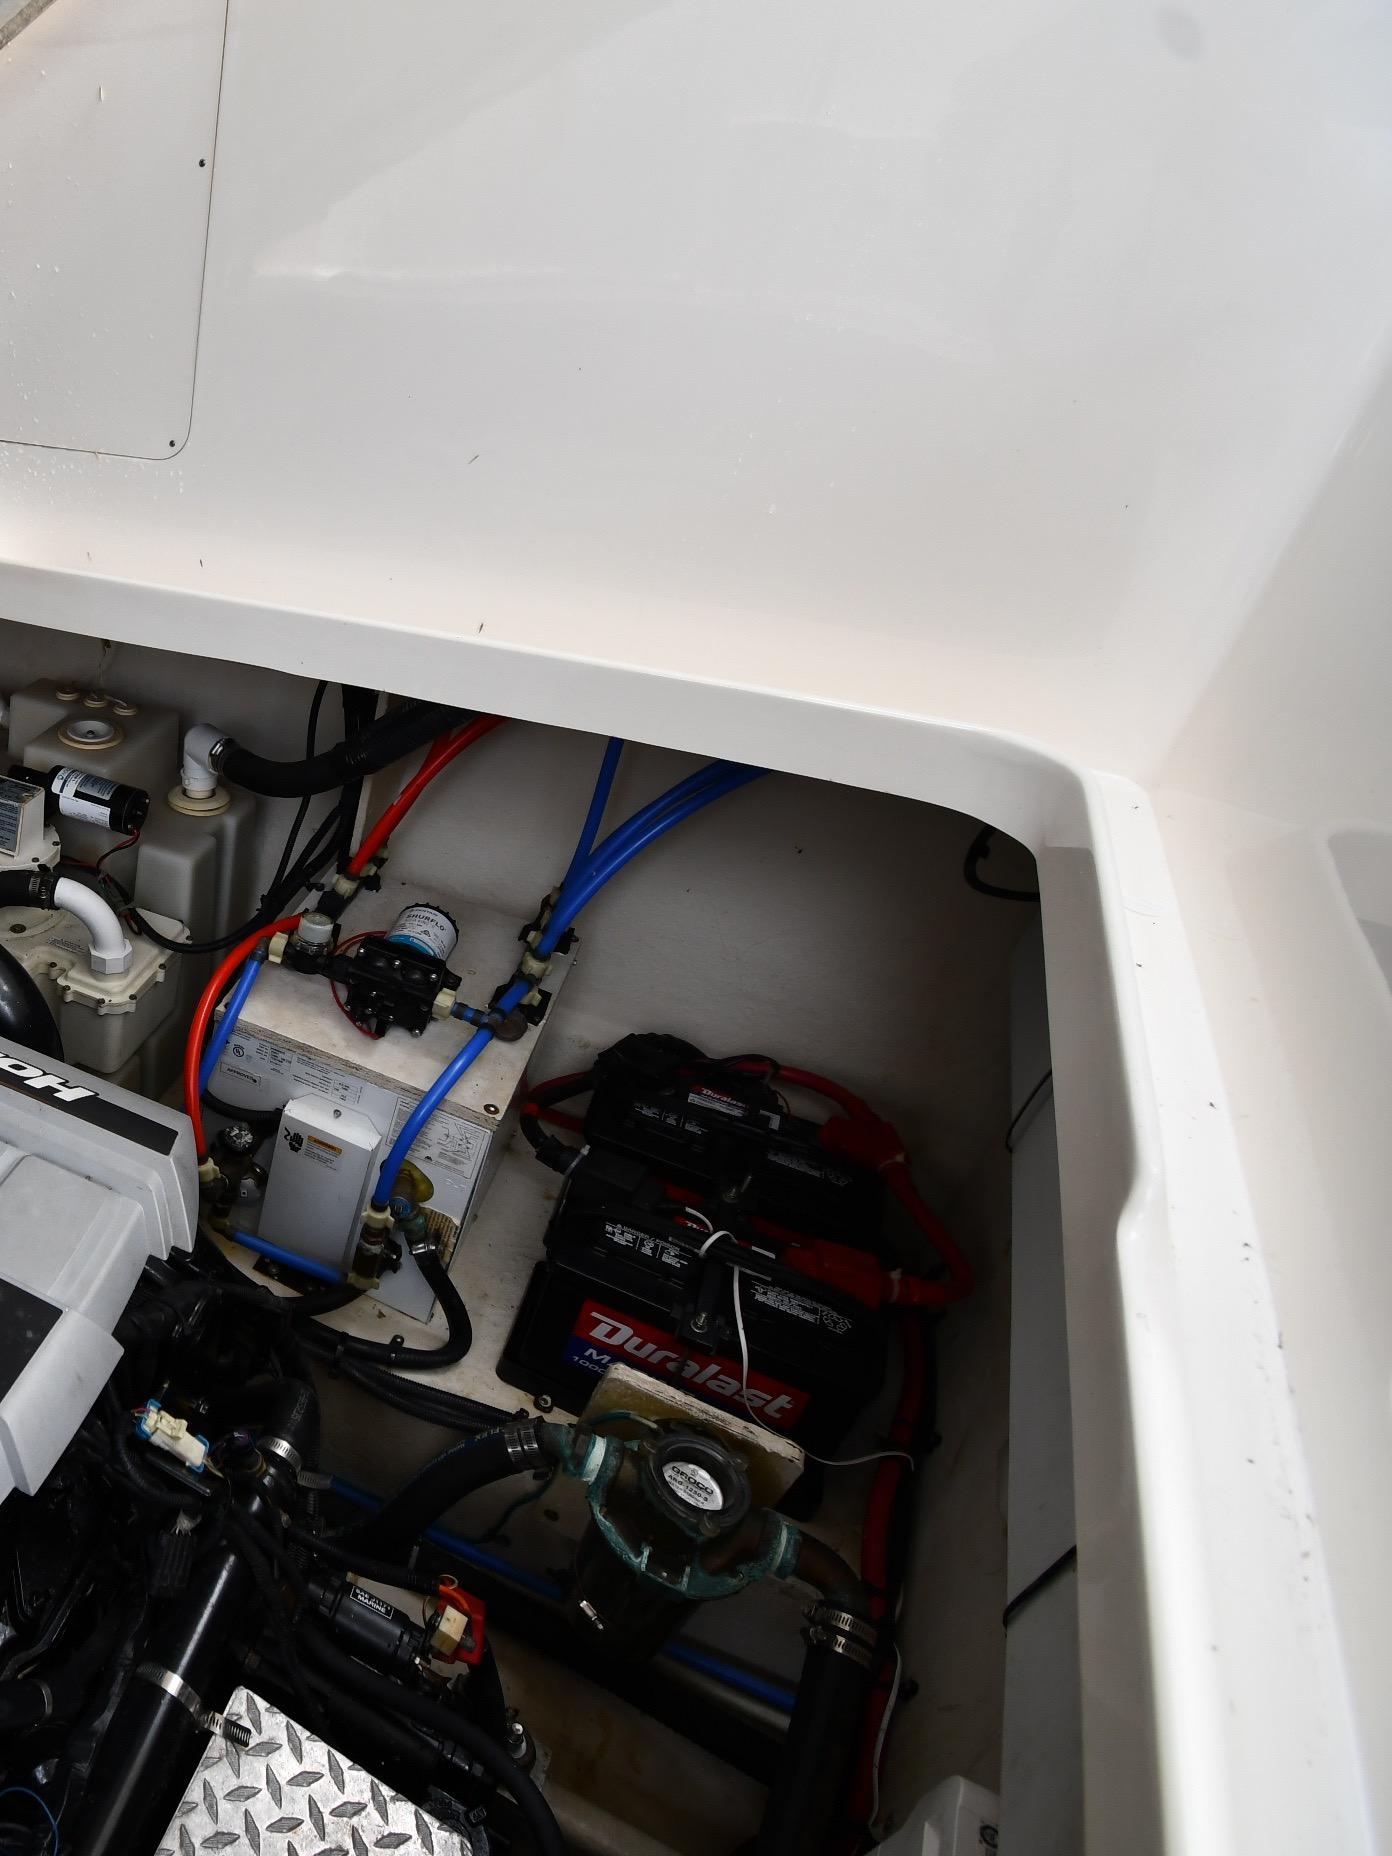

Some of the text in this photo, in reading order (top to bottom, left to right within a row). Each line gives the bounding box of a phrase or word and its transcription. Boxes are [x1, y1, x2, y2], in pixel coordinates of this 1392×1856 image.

[406, 913, 446, 932] SHURFLO
[589, 1310, 794, 1419] Duralast
[671, 1465, 714, 1495] GROCO
[357, 1594, 386, 1614] MARINE
